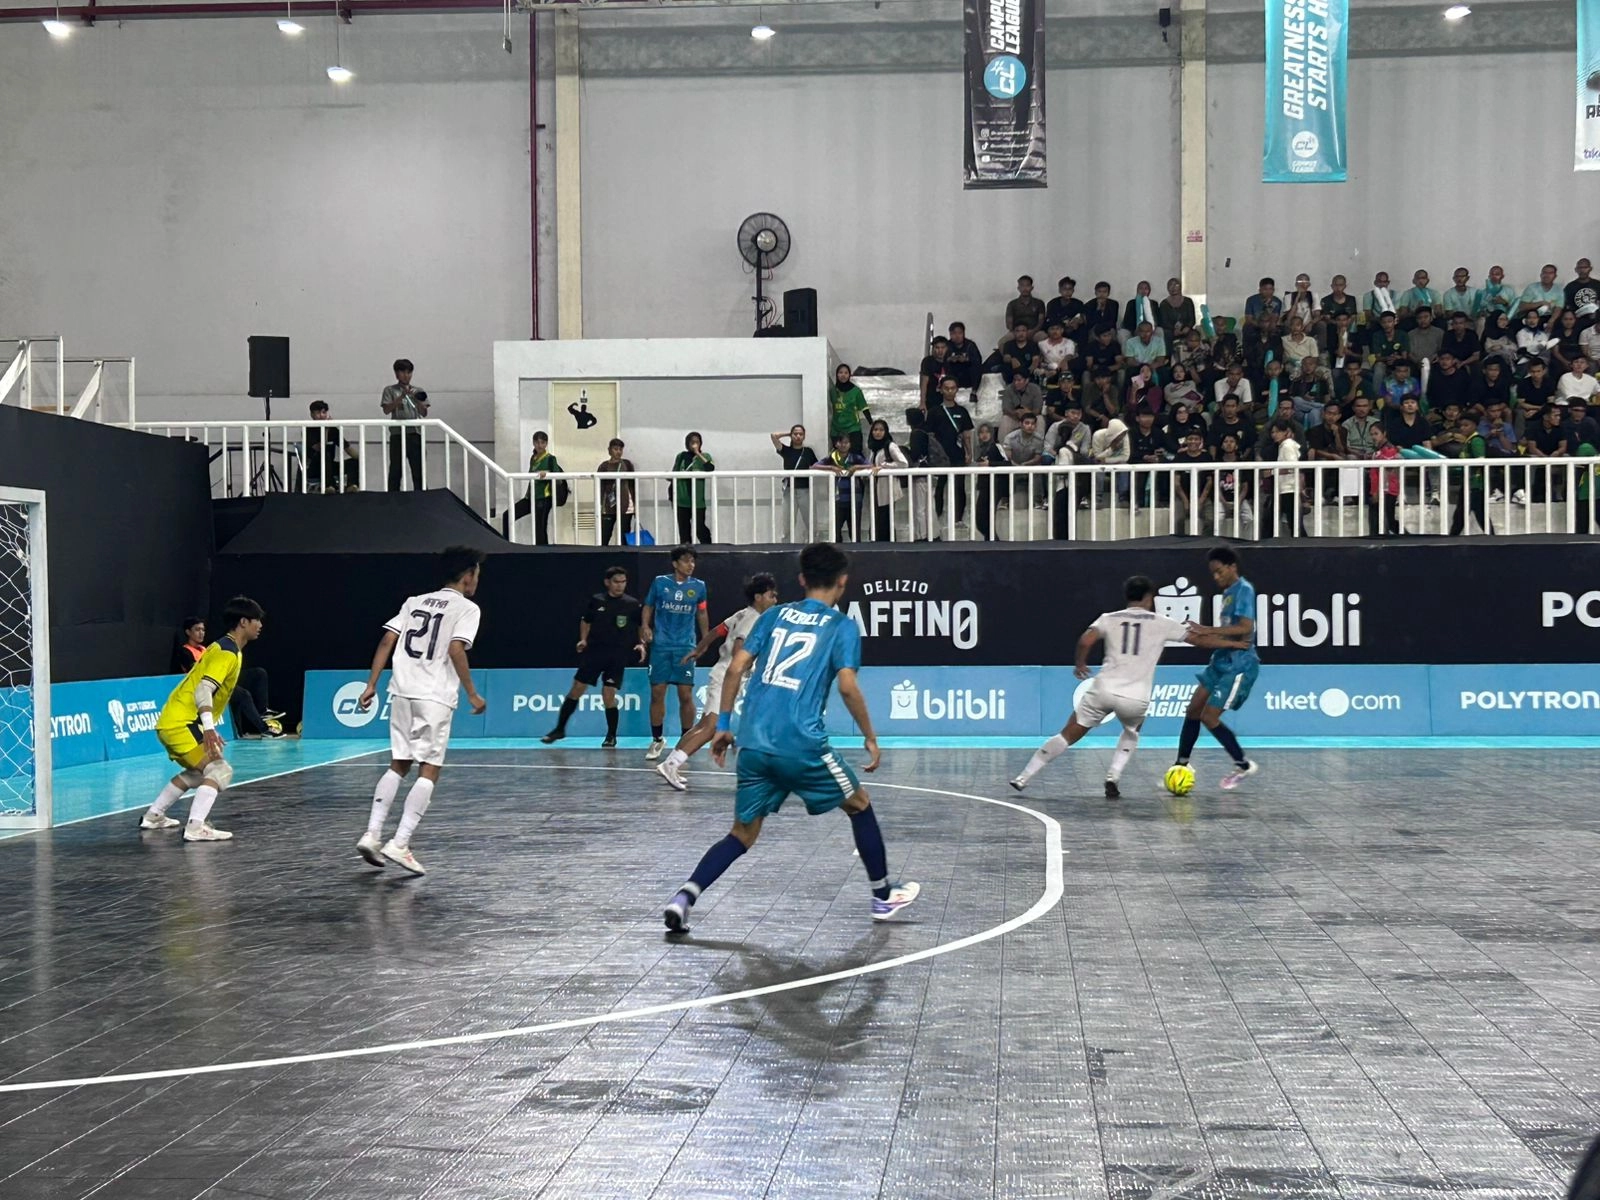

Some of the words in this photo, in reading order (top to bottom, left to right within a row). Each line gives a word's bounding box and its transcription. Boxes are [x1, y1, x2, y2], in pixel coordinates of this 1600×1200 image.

[1307, 21, 1328, 111] STARTS
[863, 579, 929, 596] DELIZIO
[661, 601, 693, 612] Jakarta
[404, 609, 445, 661] 21
[833, 600, 978, 650] AFFINO
[1120, 621, 1142, 656] 11
[761, 627, 818, 692] 12
[923, 688, 1006, 720] blibli
[1460, 691, 1600, 709] POLYTRON
